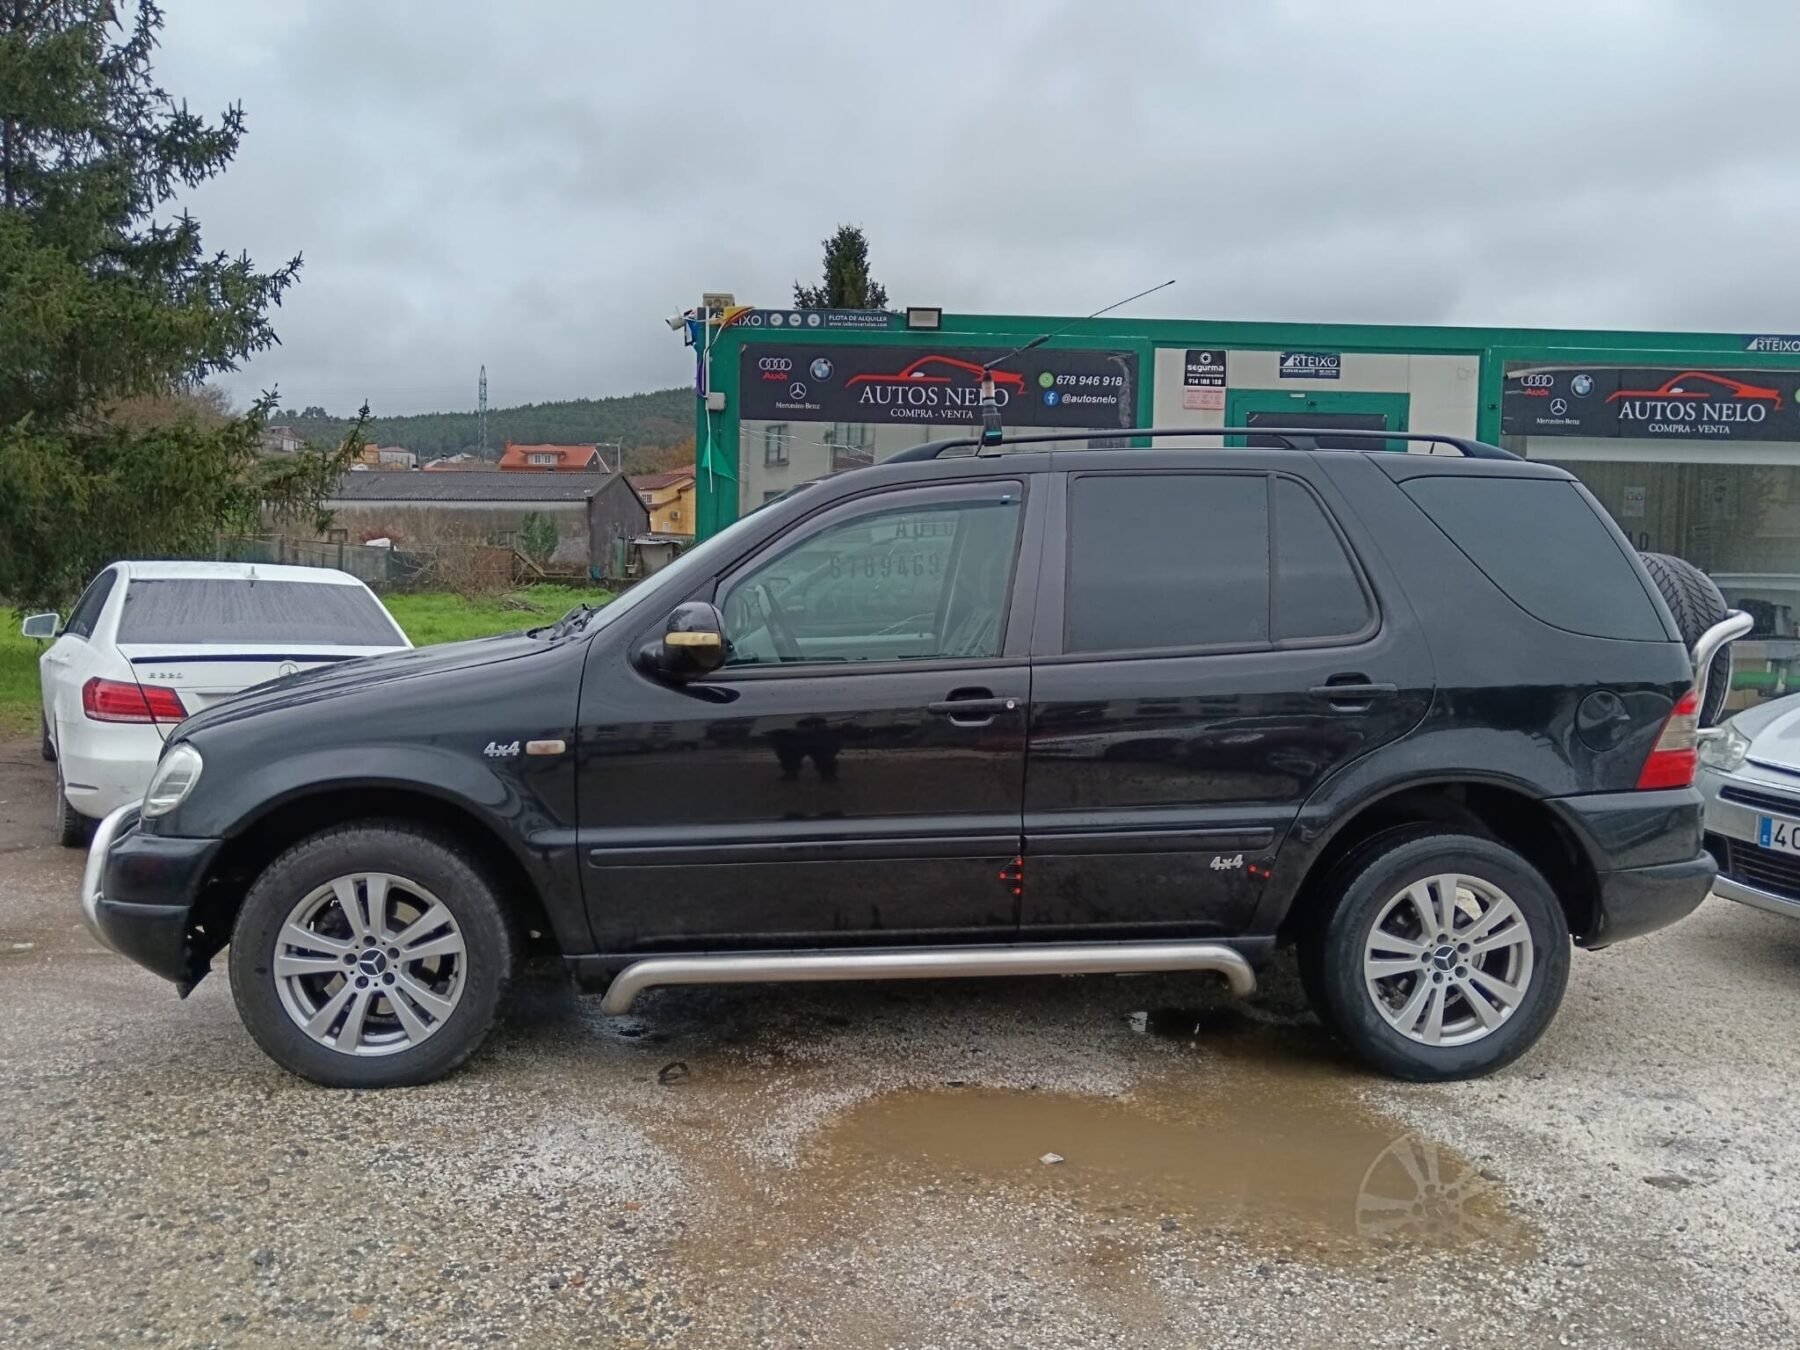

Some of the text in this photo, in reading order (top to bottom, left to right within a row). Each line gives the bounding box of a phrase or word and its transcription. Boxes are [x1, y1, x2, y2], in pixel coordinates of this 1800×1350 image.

[1187, 364, 1224, 373] segurma
[763, 371, 788, 380] Audi
[1056, 375, 1123, 386] 678 946 918
[858, 385, 938, 406] AUTOS
[1525, 388, 1549, 396] Audi
[1061, 393, 1117, 404] @autosnelo
[776, 401, 820, 410] Mercedes-Benz
[890, 408, 933, 418] COMPRA
[940, 409, 974, 419] VENTA
[1618, 401, 1766, 423] AUTOS NELO
[1648, 423, 1691, 433] COMPRA
[1698, 425, 1731, 434] VENTA
[483, 741, 520, 757] 4x4
[1209, 854, 1243, 871] 4x4
